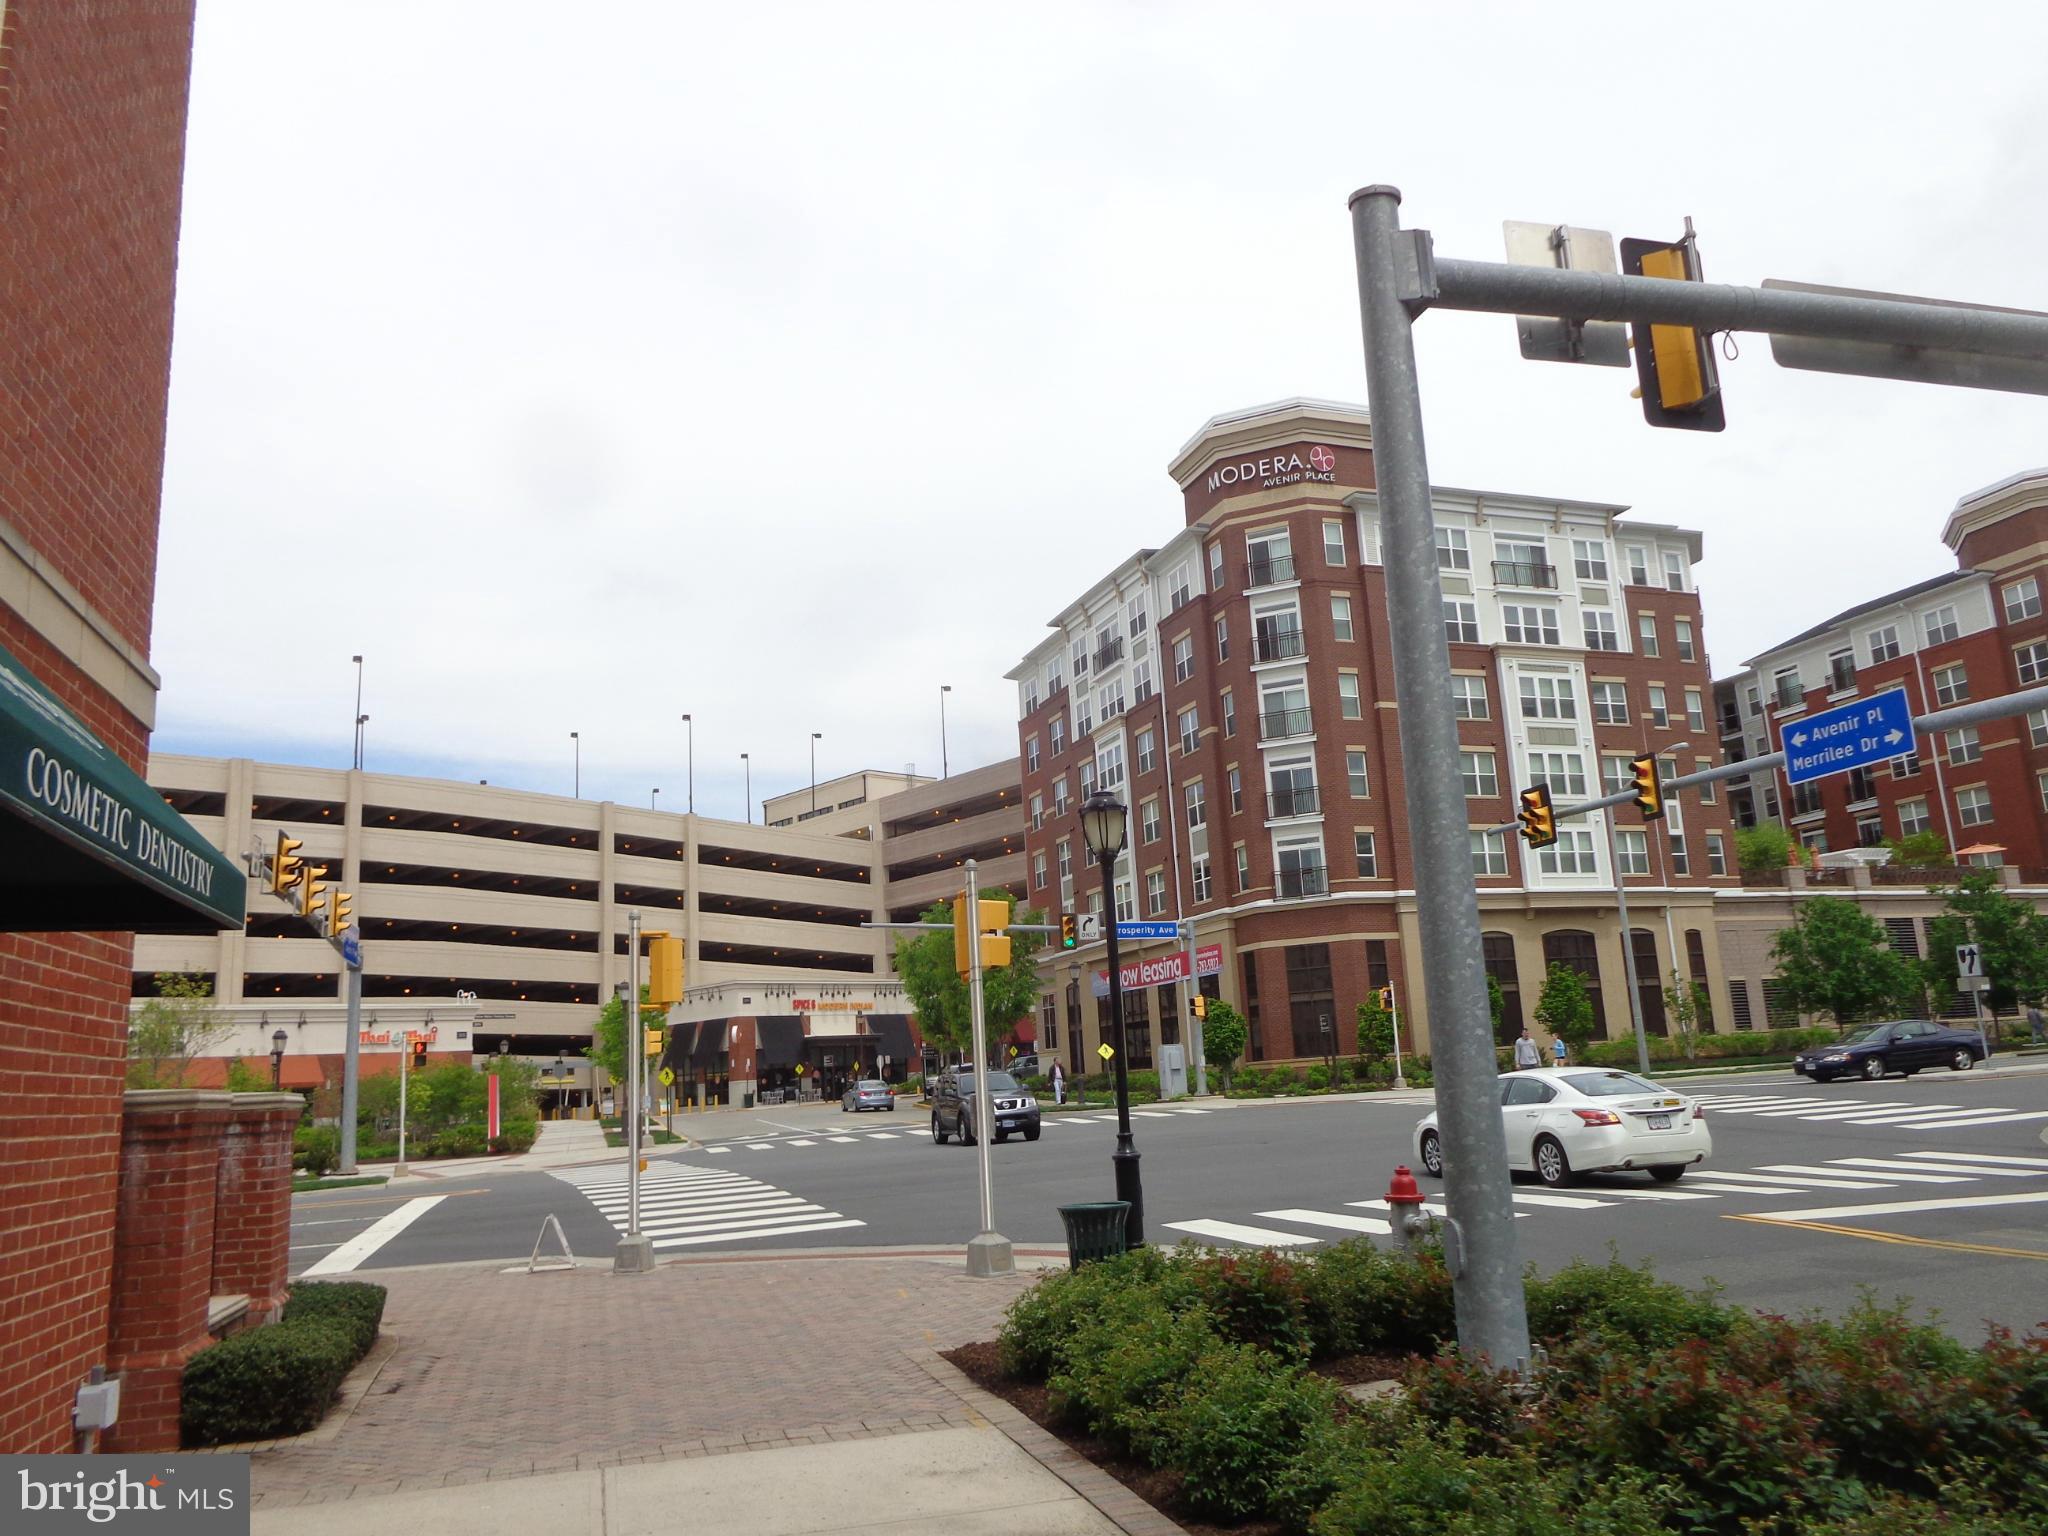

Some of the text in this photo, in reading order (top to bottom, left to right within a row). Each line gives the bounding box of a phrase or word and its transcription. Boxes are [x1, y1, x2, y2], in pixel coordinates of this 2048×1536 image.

[1263, 471, 1336, 488] AVENIR PLACE
[1812, 707, 1884, 742] Avenir Pl
[1793, 737, 1878, 772] Merrilee Dr
[27, 748, 215, 897] COSMETIC DENTISTRY
[1117, 926, 1174, 936] rosperity Ave
[1140, 957, 1182, 984] leasing
